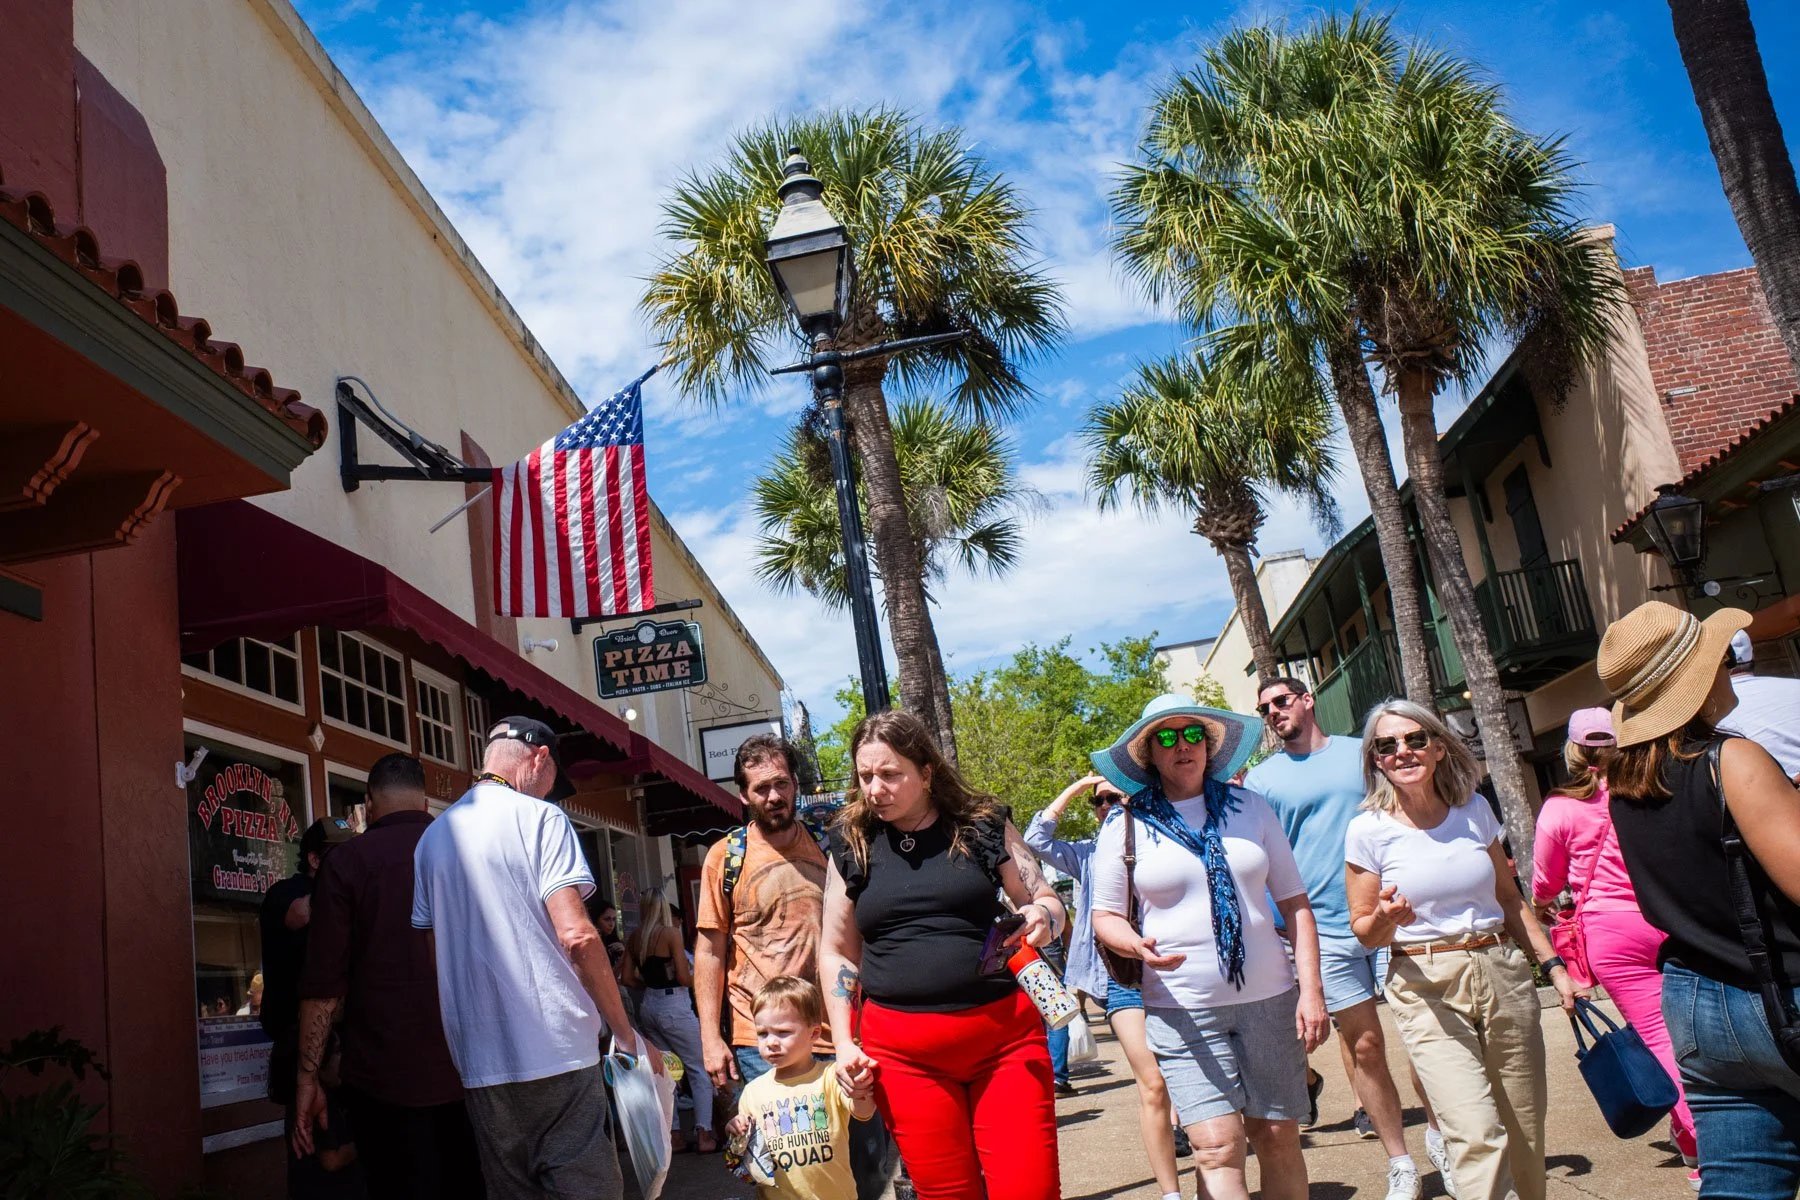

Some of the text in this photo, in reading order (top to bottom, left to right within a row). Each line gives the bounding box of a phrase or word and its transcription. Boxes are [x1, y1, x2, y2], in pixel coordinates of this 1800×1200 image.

[614, 627, 679, 643] Brick Oven
[604, 640, 693, 668] PIZZA
[611, 660, 691, 688] TIME
[632, 686, 646, 694] PASTA
[665, 680, 682, 689] ITALIAN
[708, 749, 728, 760] Red
[221, 806, 280, 842] PIZZA
[213, 864, 267, 893] Grandma's
[200, 1053, 219, 1067] Have
[220, 1052, 233, 1066] you
[234, 1049, 249, 1062] tried
[768, 1130, 830, 1152] EGG HUNTING
